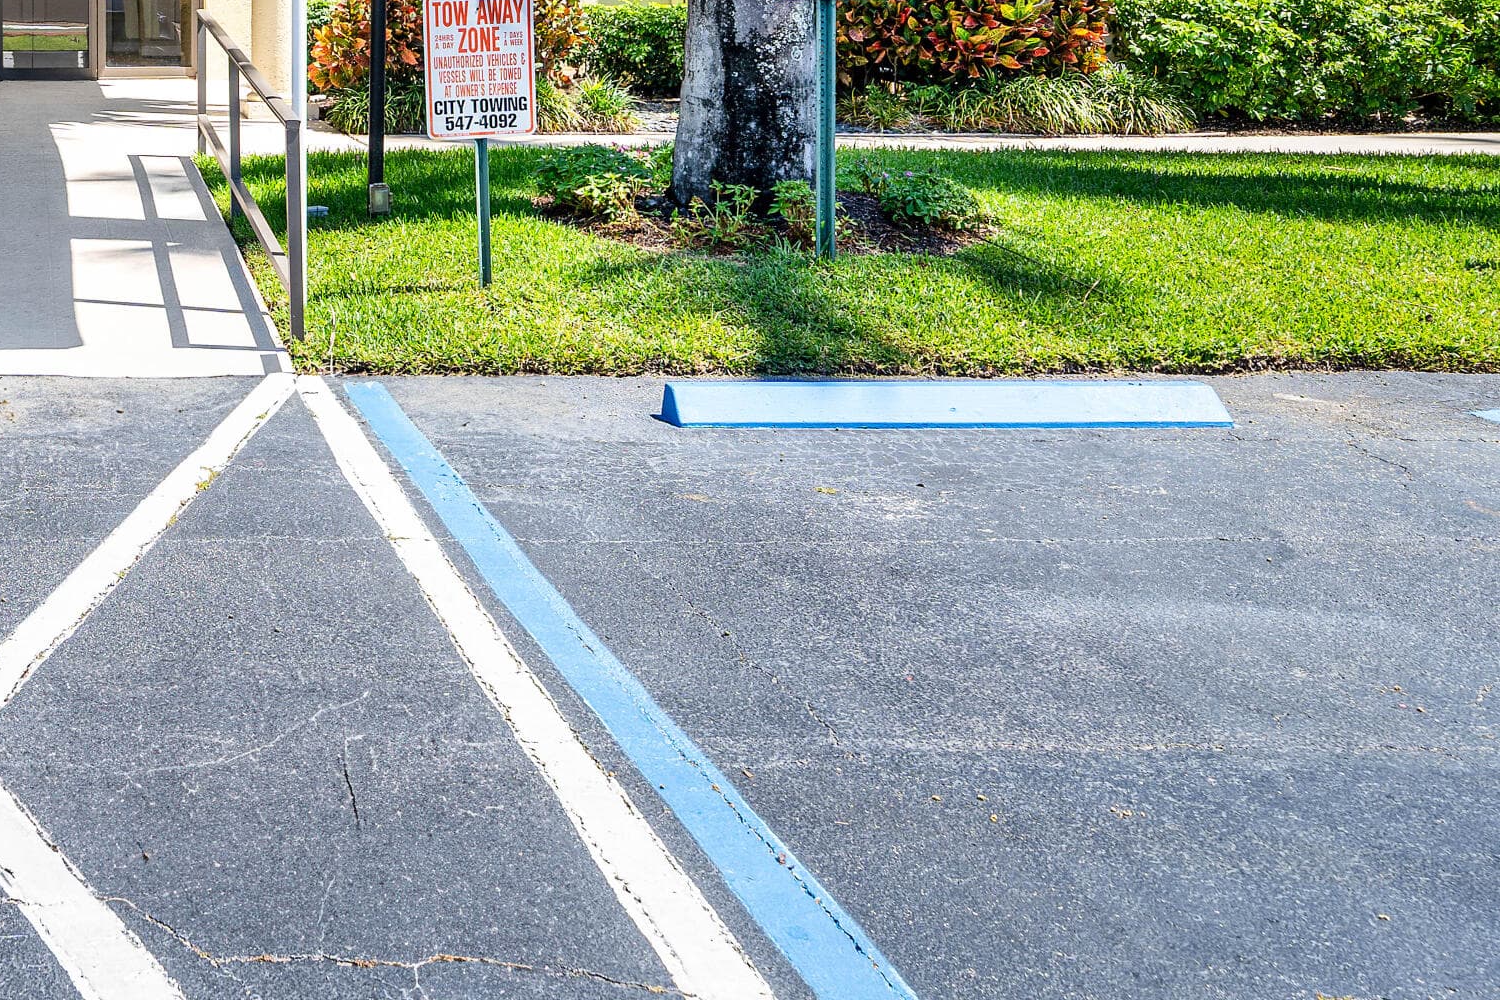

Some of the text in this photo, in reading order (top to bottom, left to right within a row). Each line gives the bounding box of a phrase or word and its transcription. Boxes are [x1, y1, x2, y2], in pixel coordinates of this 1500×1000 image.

[431, 0, 469, 27] TOW
[434, 34, 454, 42] 24HRS
[442, 41, 455, 49] DAY
[457, 26, 500, 54] ZONE
[509, 38, 524, 46] WEEK
[433, 52, 526, 70] UNAUTHORIZED VEHICLES &
[438, 67, 522, 84] VESSELS WILL BE TOWED
[444, 82, 517, 98] AT OWNER'S EXPENSE
[434, 96, 528, 116] CITY TOWING
[445, 113, 517, 131] 547-4092
